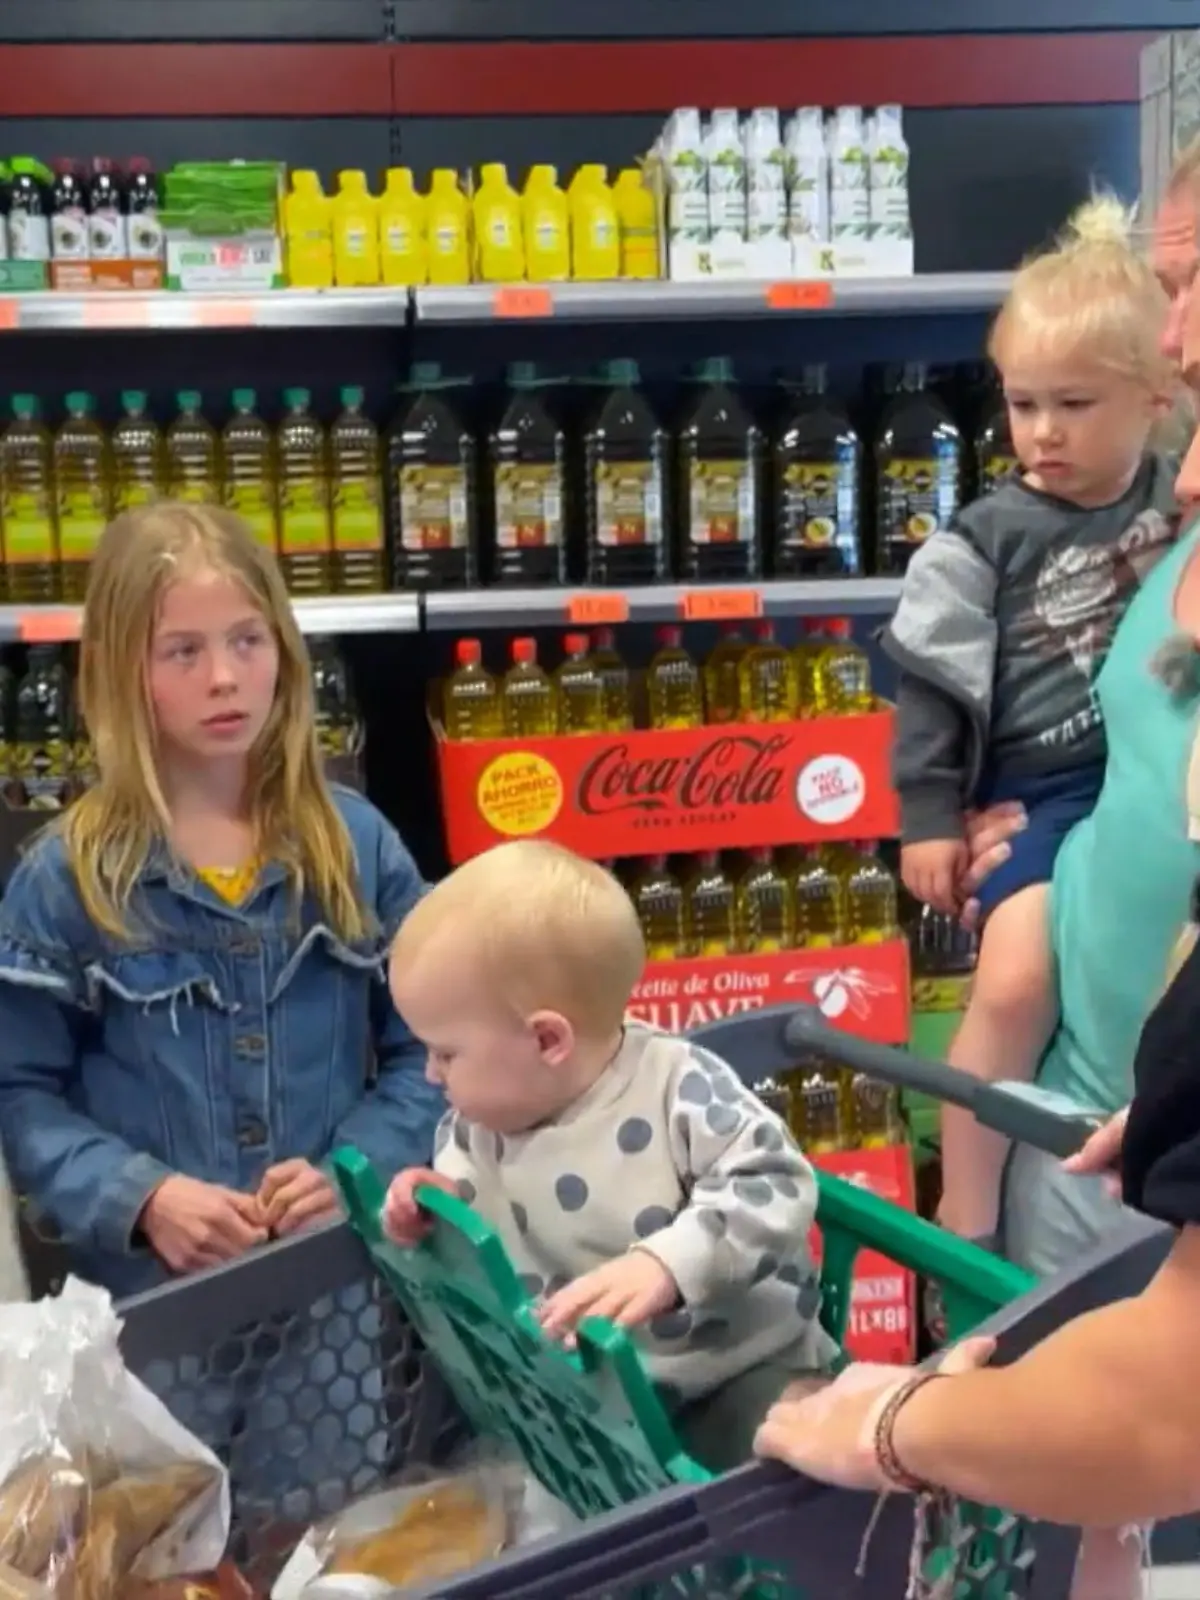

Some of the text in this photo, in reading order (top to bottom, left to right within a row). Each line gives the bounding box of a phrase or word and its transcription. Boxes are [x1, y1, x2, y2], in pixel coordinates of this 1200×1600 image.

[482, 777, 558, 804] AHORRO
[630, 970, 770, 998] ceite de Oliva
